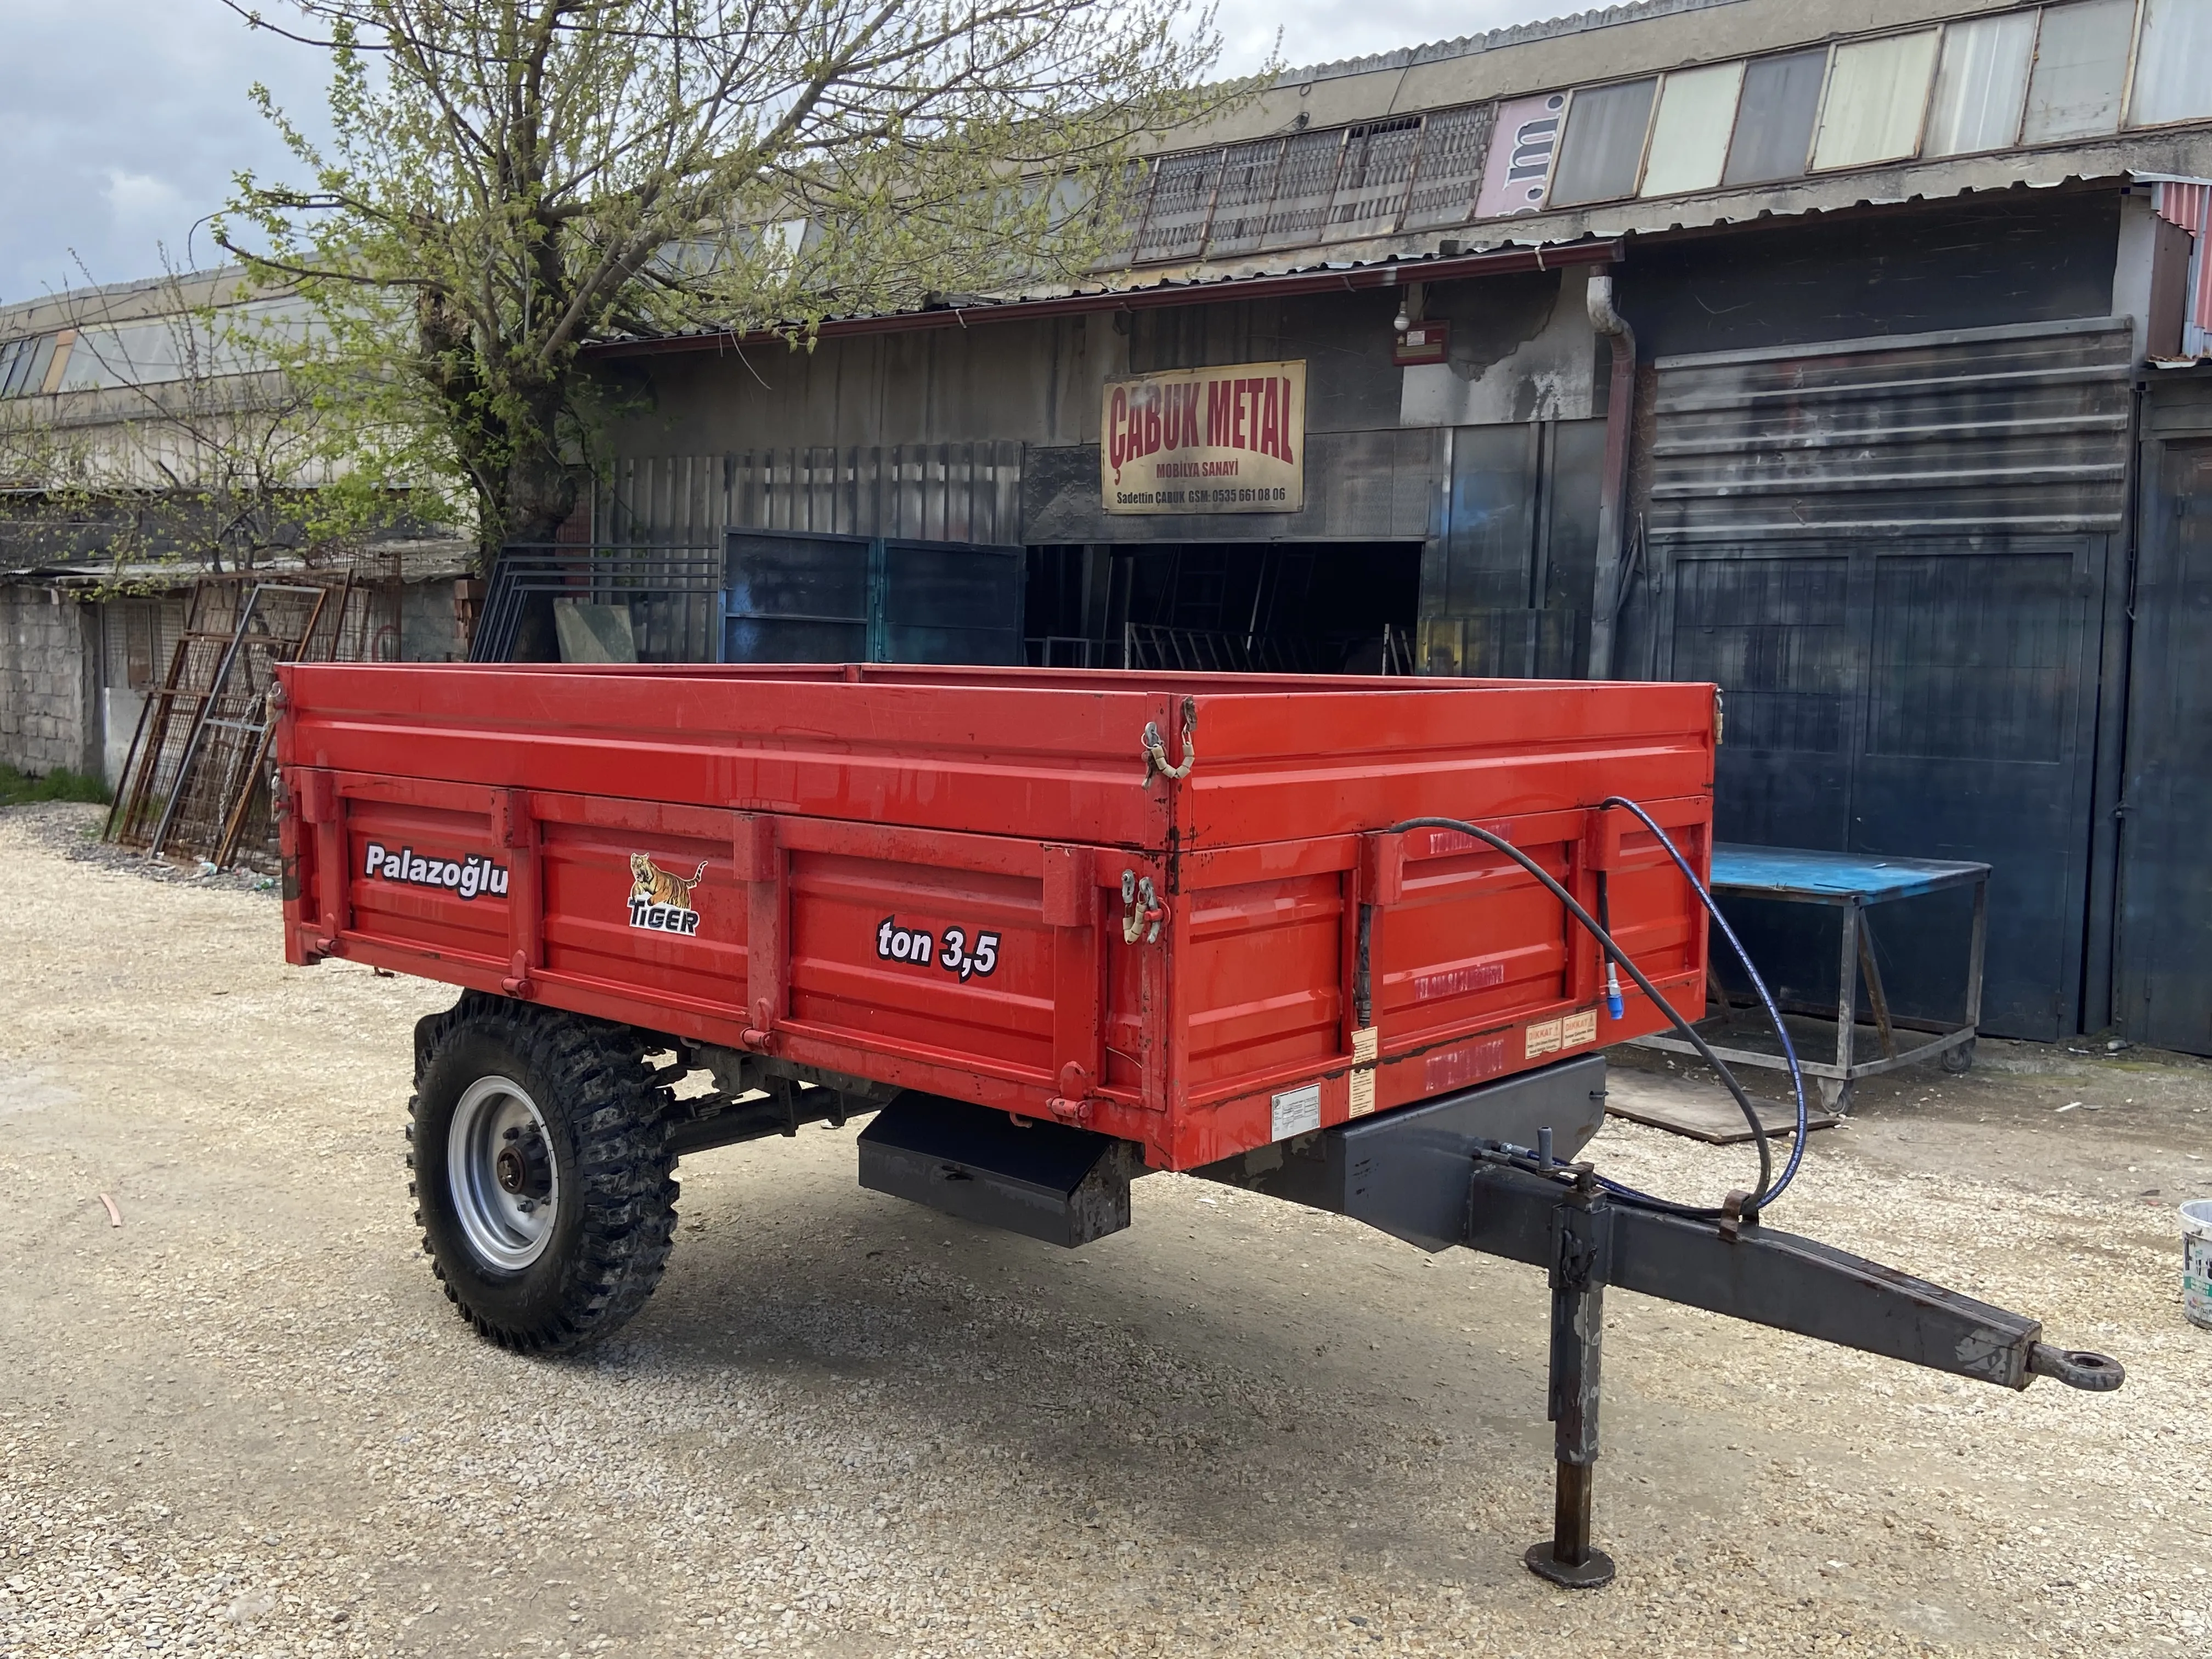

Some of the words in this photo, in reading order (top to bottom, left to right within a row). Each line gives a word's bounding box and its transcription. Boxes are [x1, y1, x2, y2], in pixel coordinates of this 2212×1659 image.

[1110, 382, 1201, 486] ÇABUK
[1207, 377, 1294, 465] METAL
[1156, 460, 1200, 478] MOBİLYA
[1202, 458, 1239, 477] SANAYİ
[1116, 492, 1153, 504] Sadettin
[1155, 490, 1186, 506] ÇABUK
[1212, 489, 1236, 502] 0535
[1273, 487, 1286, 500] 06
[365, 843, 509, 899] Palazoğlu
[878, 920, 932, 963] ton
[940, 929, 998, 979] 3,5
